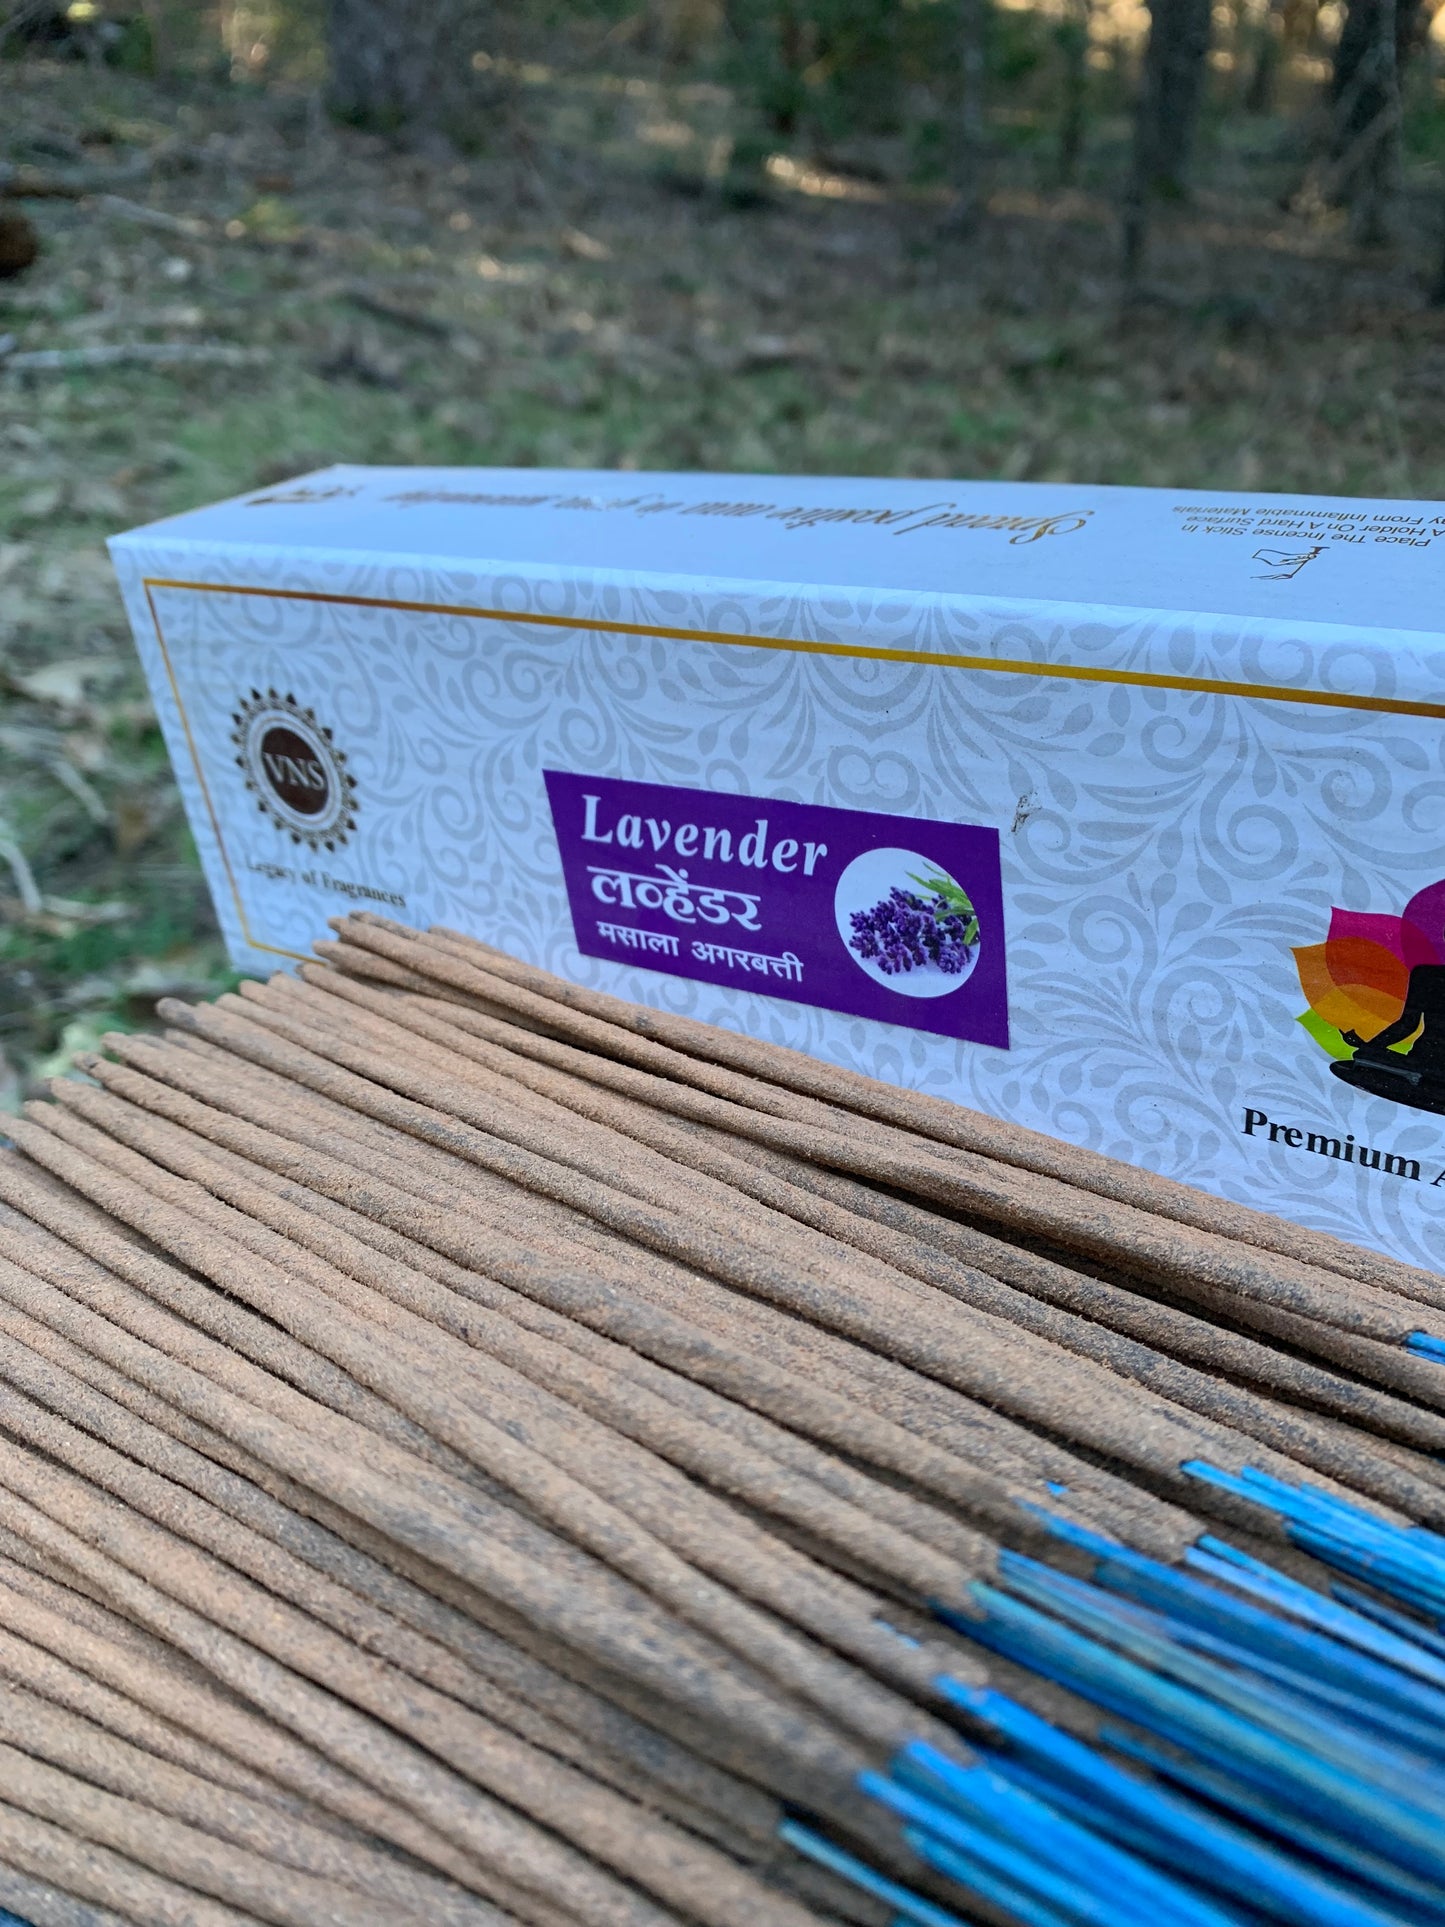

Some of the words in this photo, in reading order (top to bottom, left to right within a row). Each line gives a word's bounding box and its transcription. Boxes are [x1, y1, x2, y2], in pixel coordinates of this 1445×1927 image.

[1172, 506, 1251, 516] Materials
[1256, 508, 1368, 522] Inflammable
[1186, 516, 1255, 526] Surface
[1258, 518, 1305, 529] Hard
[1309, 521, 1324, 530] A
[1373, 515, 1424, 525] From
[1181, 524, 1199, 533] In
[1203, 525, 1248, 536] Stick
[1327, 522, 1355, 532] On
[1359, 525, 1426, 536] Holder
[1253, 528, 1328, 541] Incense
[1331, 532, 1367, 544] The
[1374, 536, 1432, 547] Place
[262, 752, 326, 790] VNS
[580, 794, 829, 876] Lavender
[302, 869, 317, 885] of
[321, 871, 408, 908] Fragrances
[596, 920, 680, 957] मसाला
[691, 940, 805, 982] अगरबत्ती
[1241, 1106, 1422, 1182] Premium
